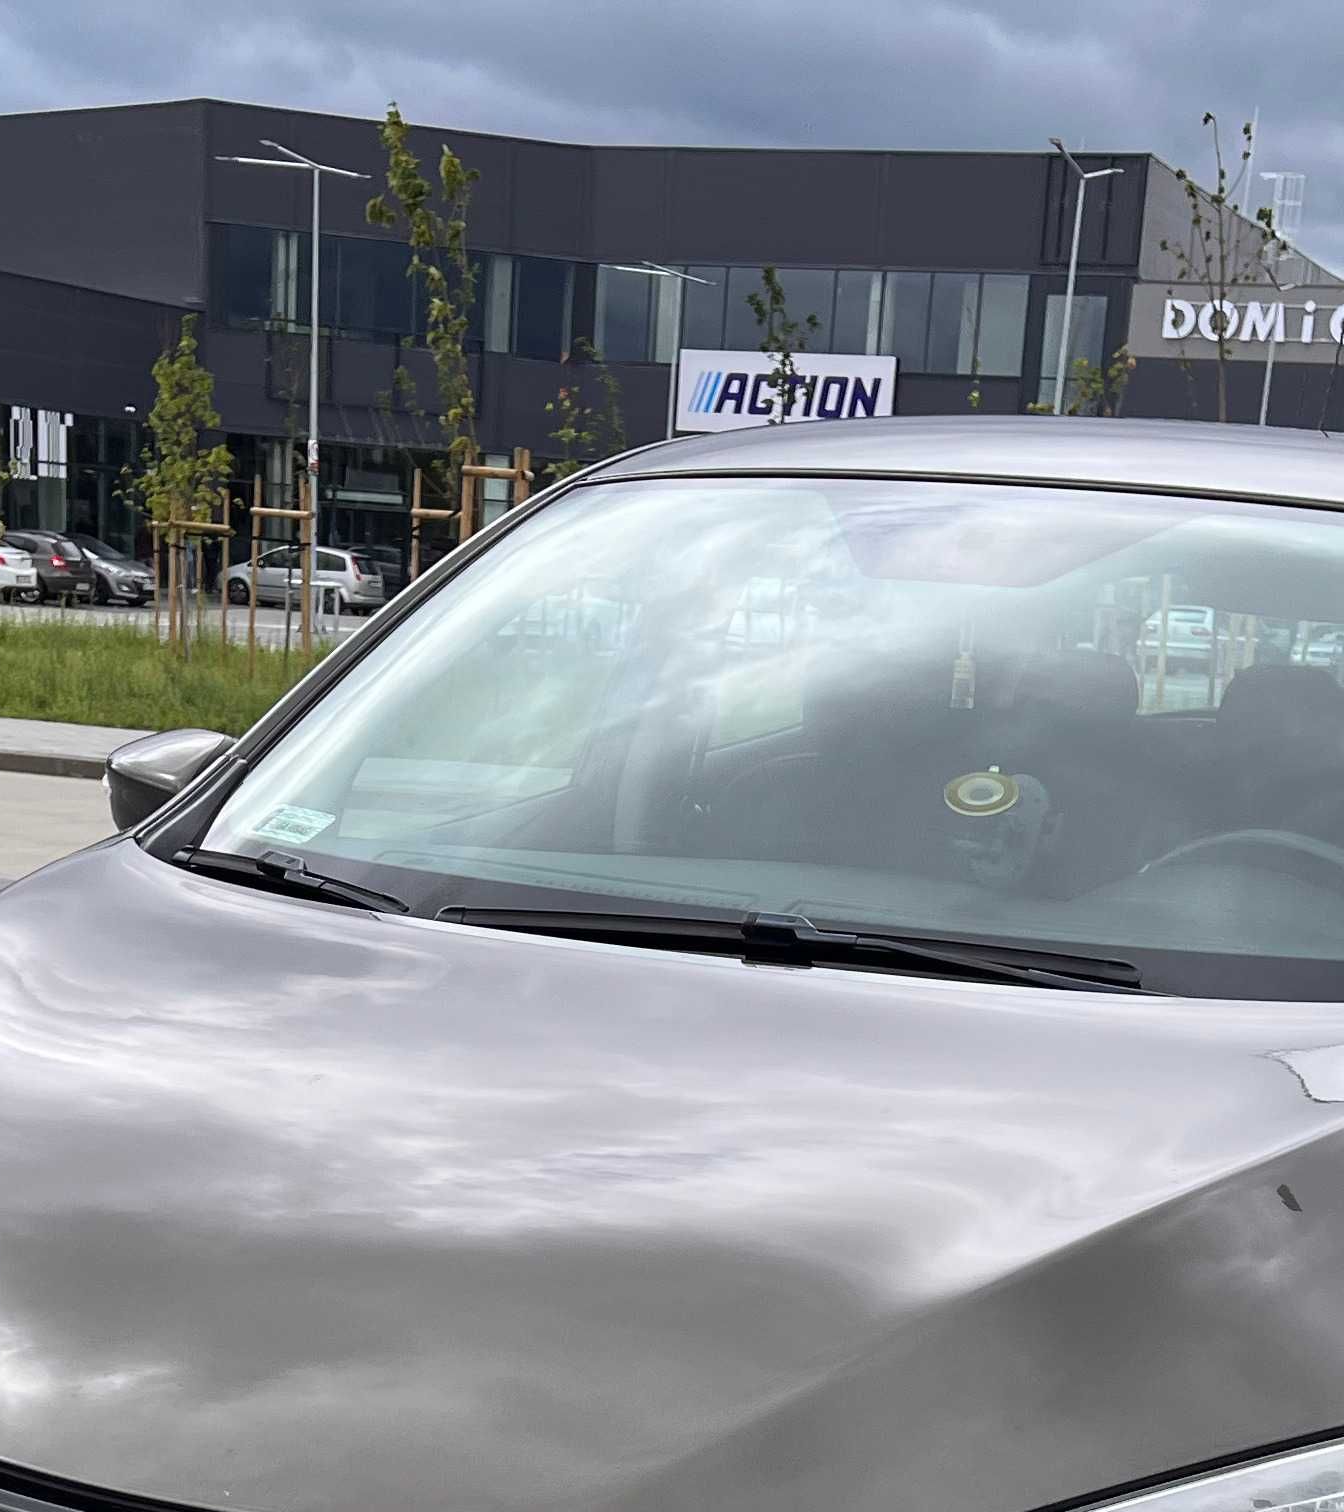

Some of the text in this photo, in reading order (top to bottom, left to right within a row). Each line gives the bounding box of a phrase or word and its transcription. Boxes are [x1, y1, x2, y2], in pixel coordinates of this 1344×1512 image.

[1162, 299, 1285, 342] DOM
[1301, 299, 1317, 343] i
[714, 373, 881, 418] ACTION
